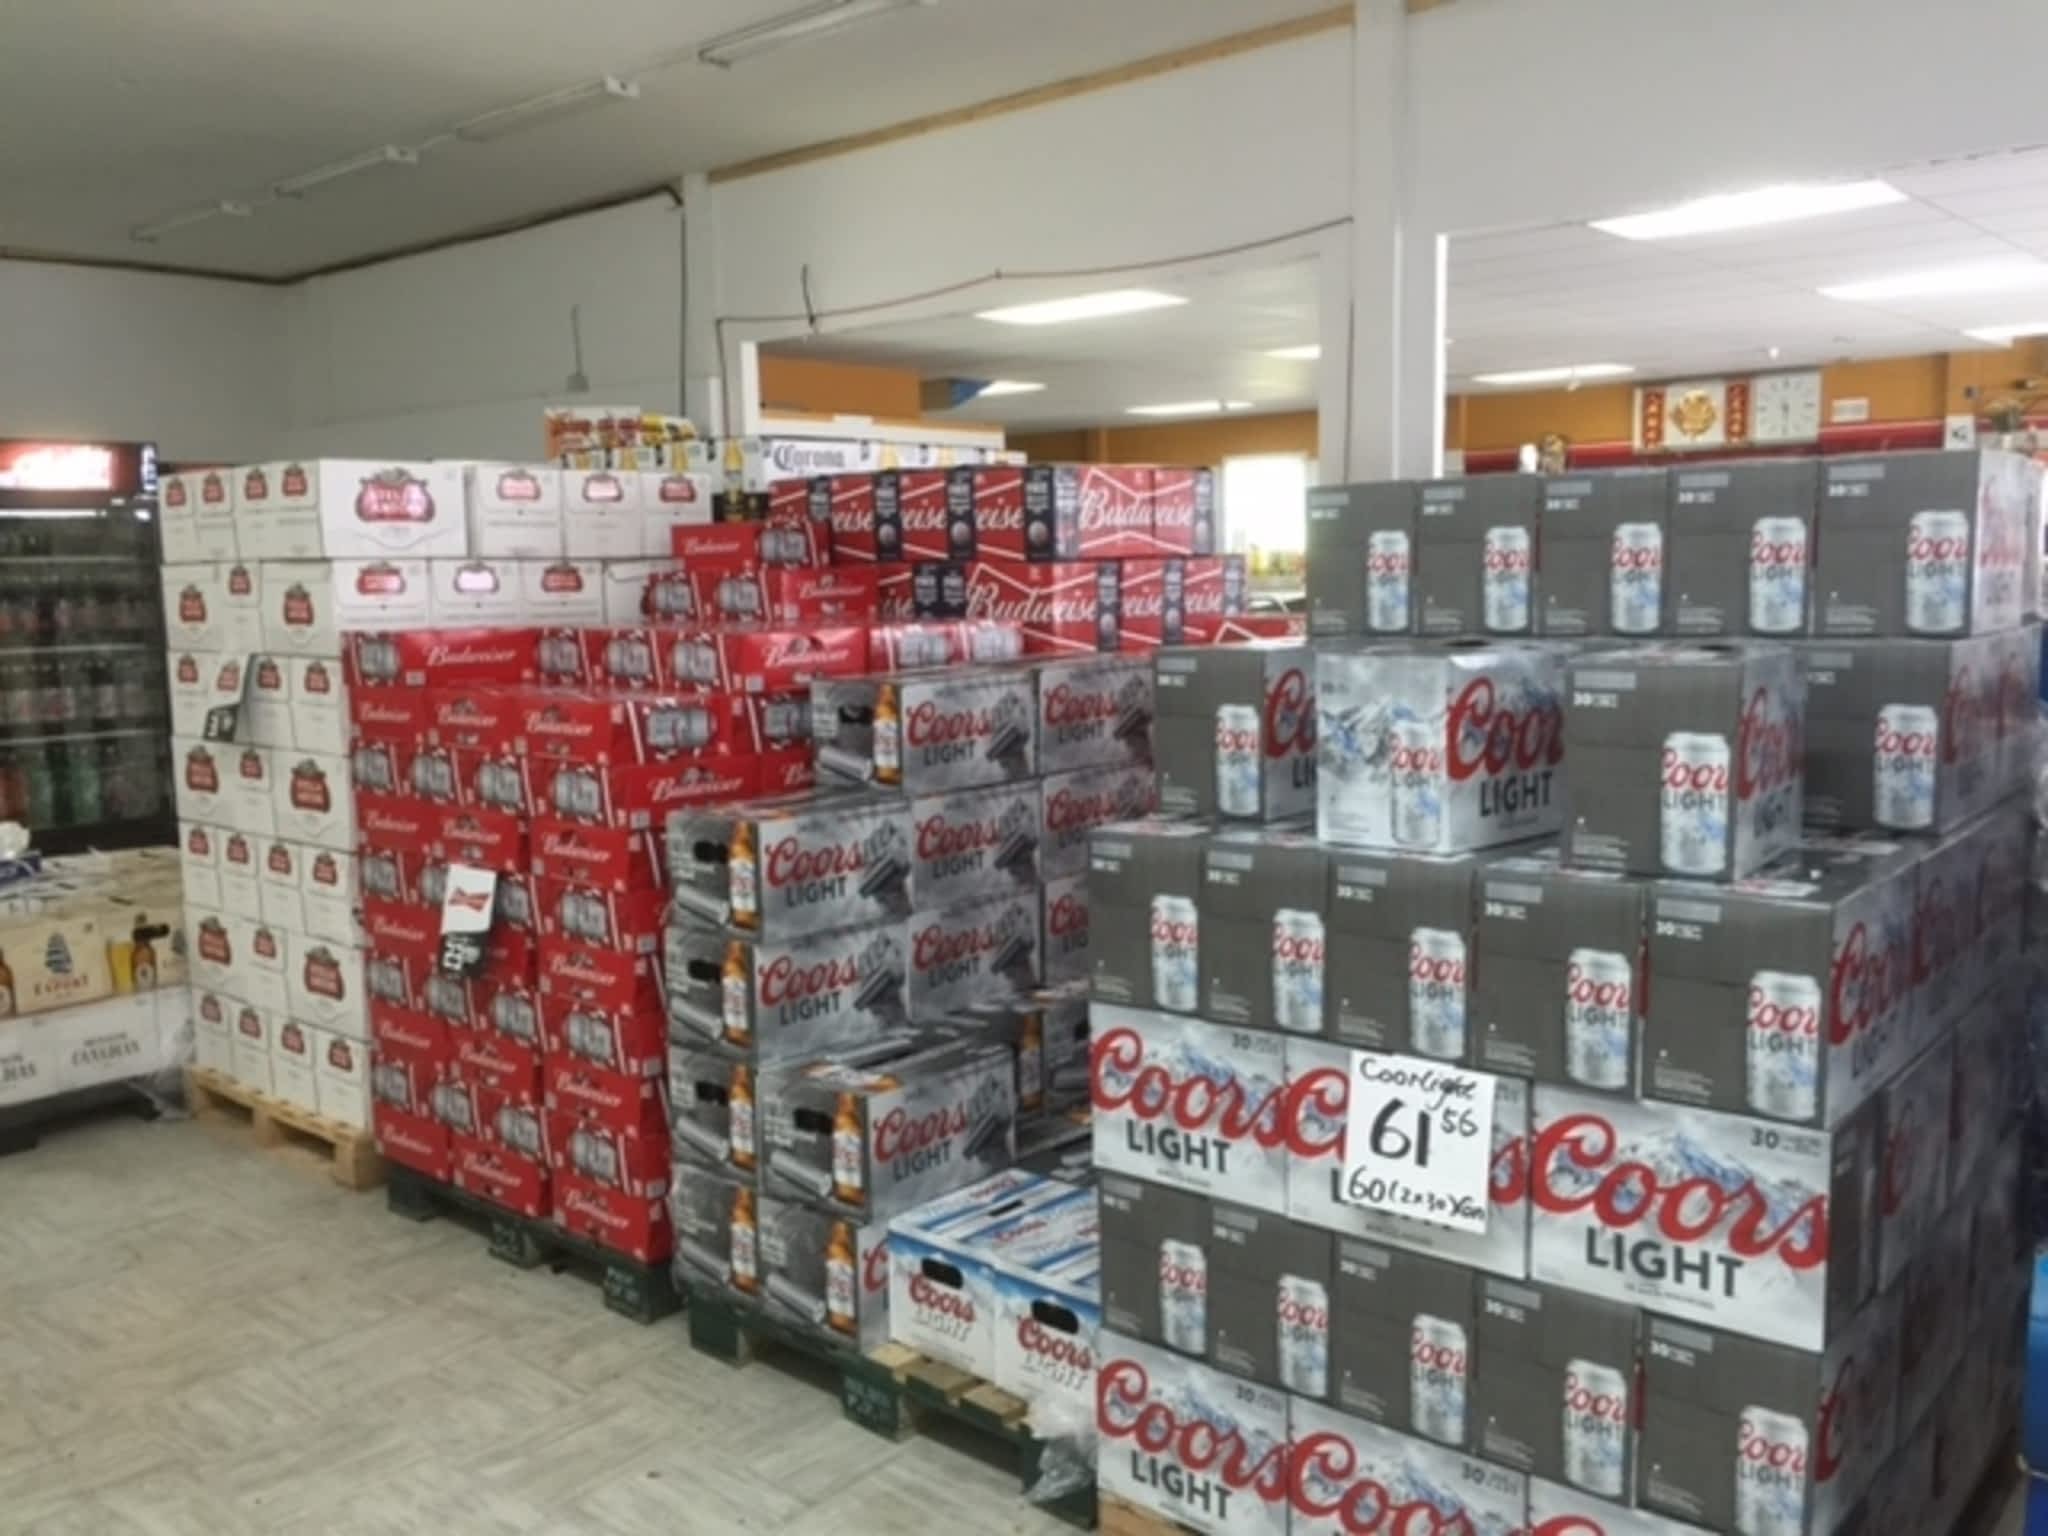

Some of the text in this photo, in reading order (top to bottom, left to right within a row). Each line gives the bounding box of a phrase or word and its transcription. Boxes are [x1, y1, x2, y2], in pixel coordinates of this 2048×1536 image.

[773, 443, 845, 472] Corona
[1446, 676, 1565, 781] Coor
[1480, 770, 1553, 818] LIGHT
[765, 834, 866, 888] Coors
[786, 871, 848, 907] LIGHT
[760, 955, 859, 1008] Coors
[1091, 1027, 1288, 1148] Coors
[1126, 1118, 1231, 1174] LIGHT
[1369, 1097, 1431, 1168] 61
[1440, 1107, 1478, 1137] 56
[1530, 1113, 1829, 1270] Coors
[1586, 1225, 1744, 1298] LIGHT
[909, 1271, 977, 1324] Coors
[1018, 1315, 1093, 1371] Coors
[1097, 1358, 1289, 1502] Coors
[1131, 1450, 1232, 1520] LIGHT
